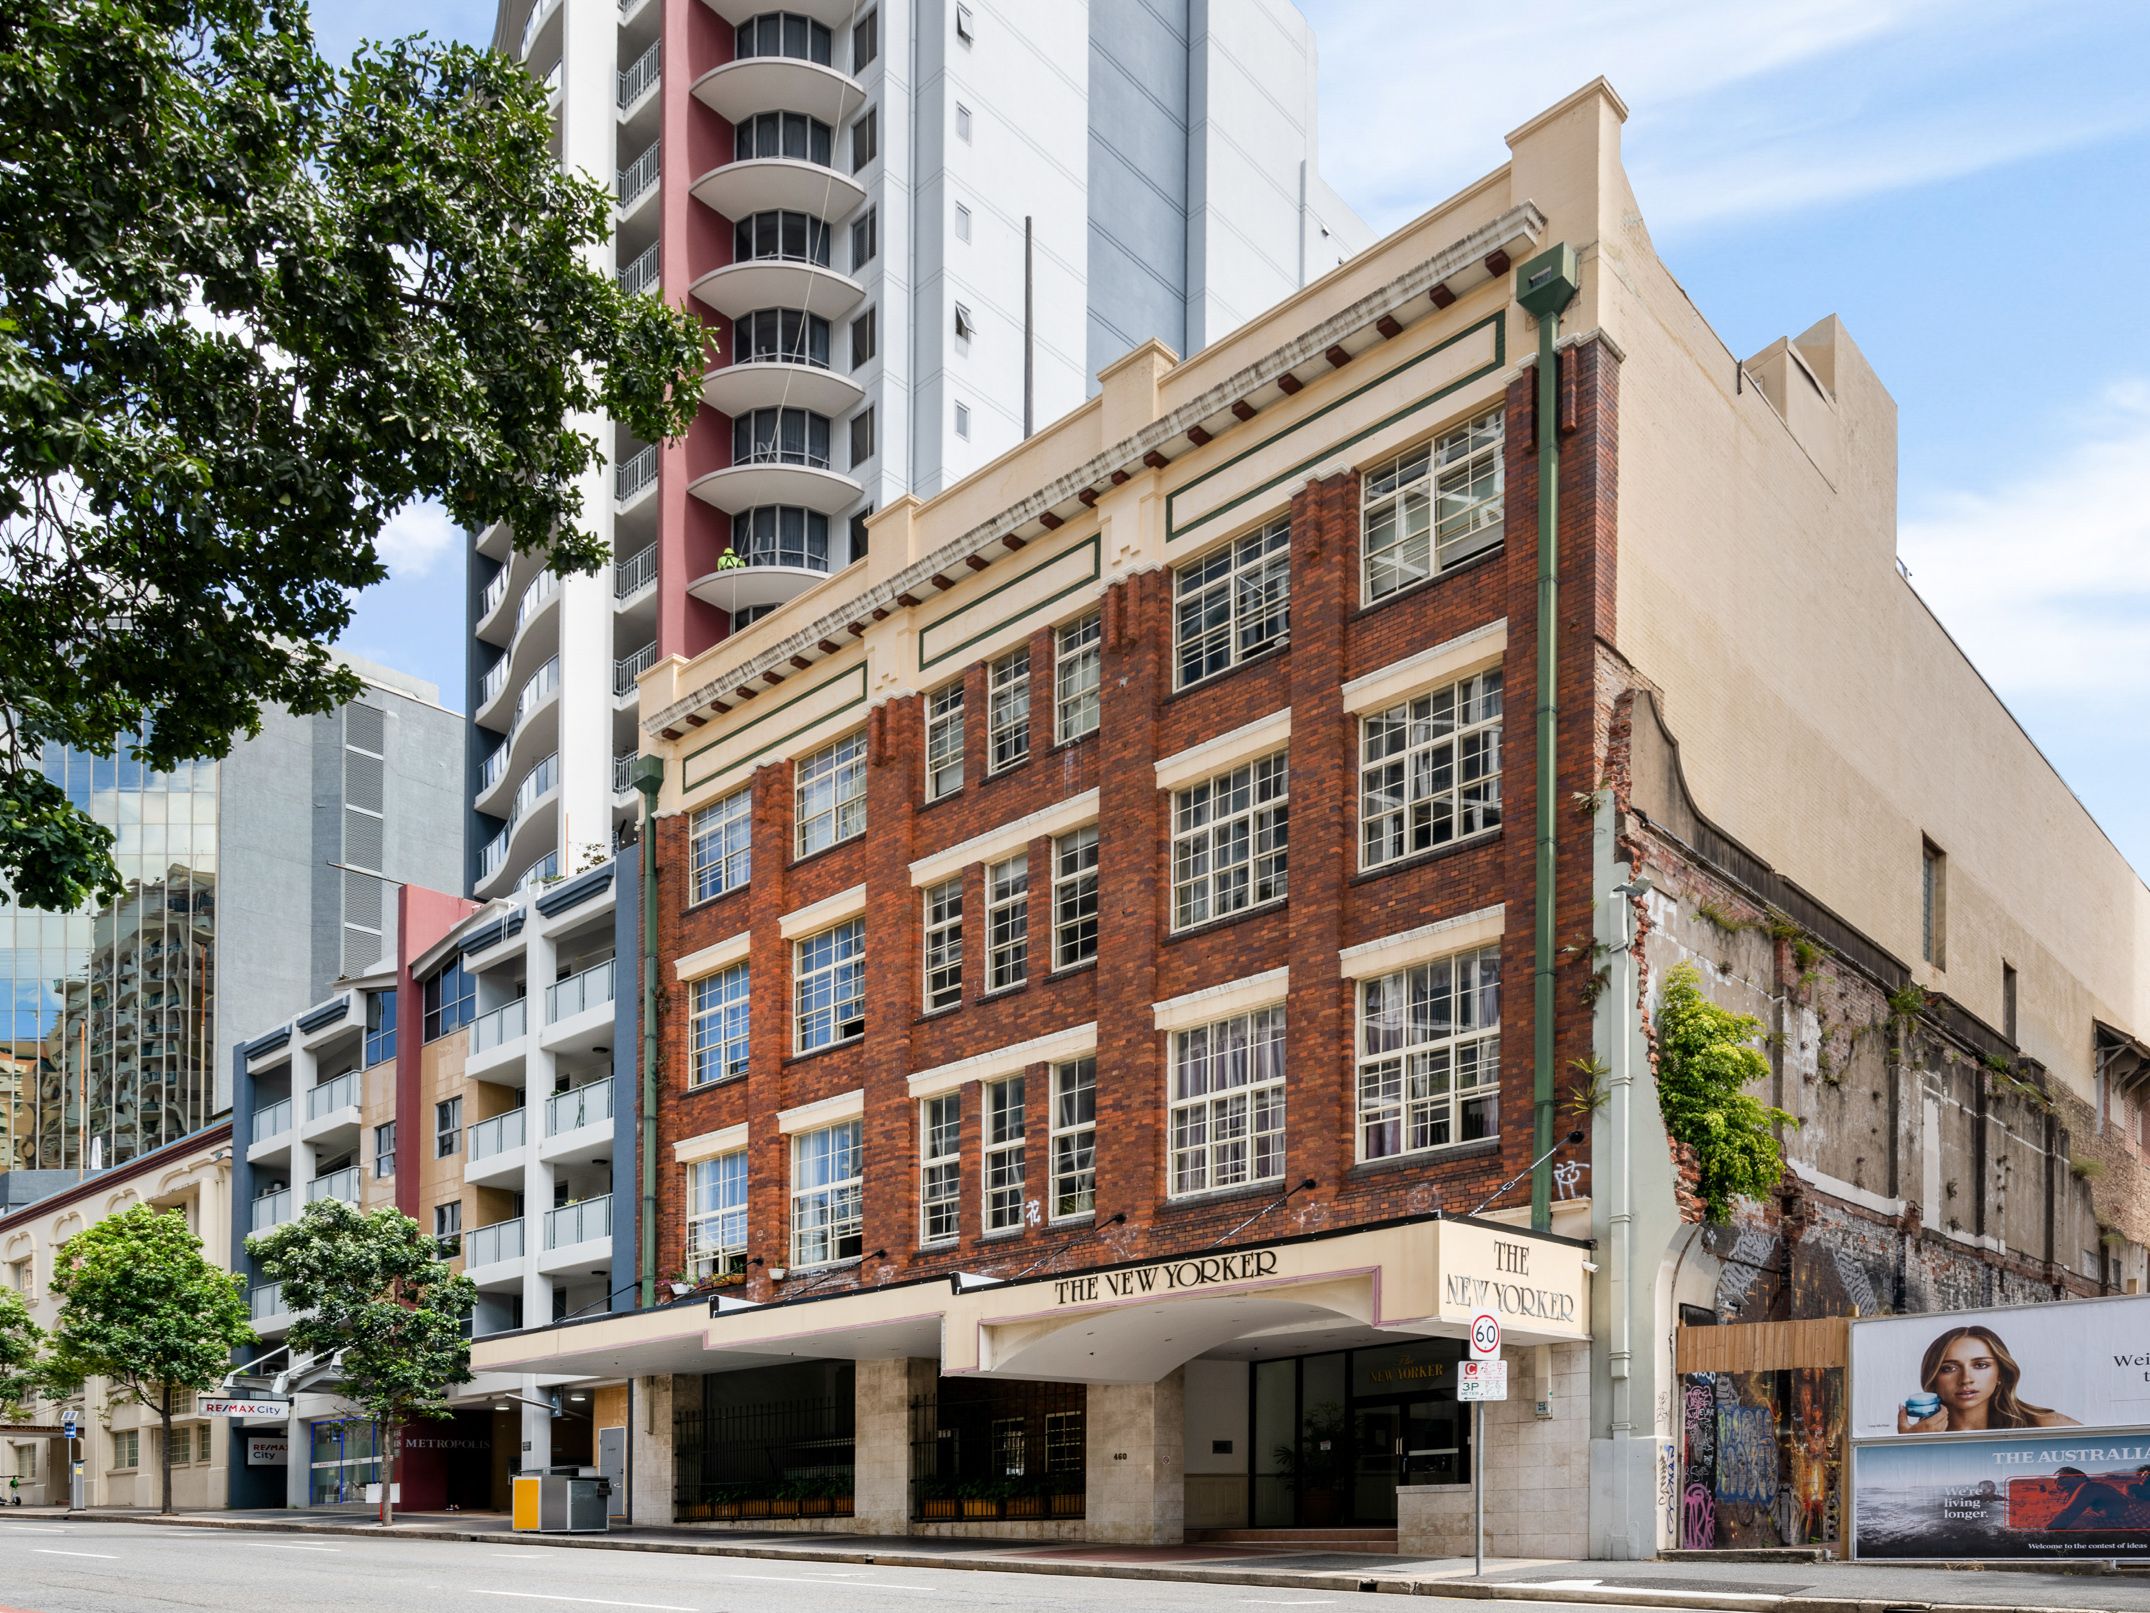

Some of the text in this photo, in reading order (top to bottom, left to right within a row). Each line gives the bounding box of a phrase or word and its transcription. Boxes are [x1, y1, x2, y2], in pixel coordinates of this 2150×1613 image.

[1494, 1239, 1530, 1277] THE
[1055, 1275, 1099, 1305] THE
[1163, 1250, 1279, 1289] YORKER
[1446, 1273, 1575, 1323] NEW YORKER
[1475, 1325, 1496, 1343] 60
[1467, 1363, 1476, 1375] C
[1462, 1382, 1479, 1391] 3P
[206, 1403, 281, 1415] RE/MAX City
[406, 1439, 491, 1449] METROPOLIS
[253, 1451, 276, 1460] City
[1113, 1452, 1128, 1460] 460
[1992, 1451, 2035, 1465] THE
[1944, 1486, 1983, 1496] We're
[1944, 1497, 1981, 1509] living
[1944, 1509, 1989, 1521] longer.
